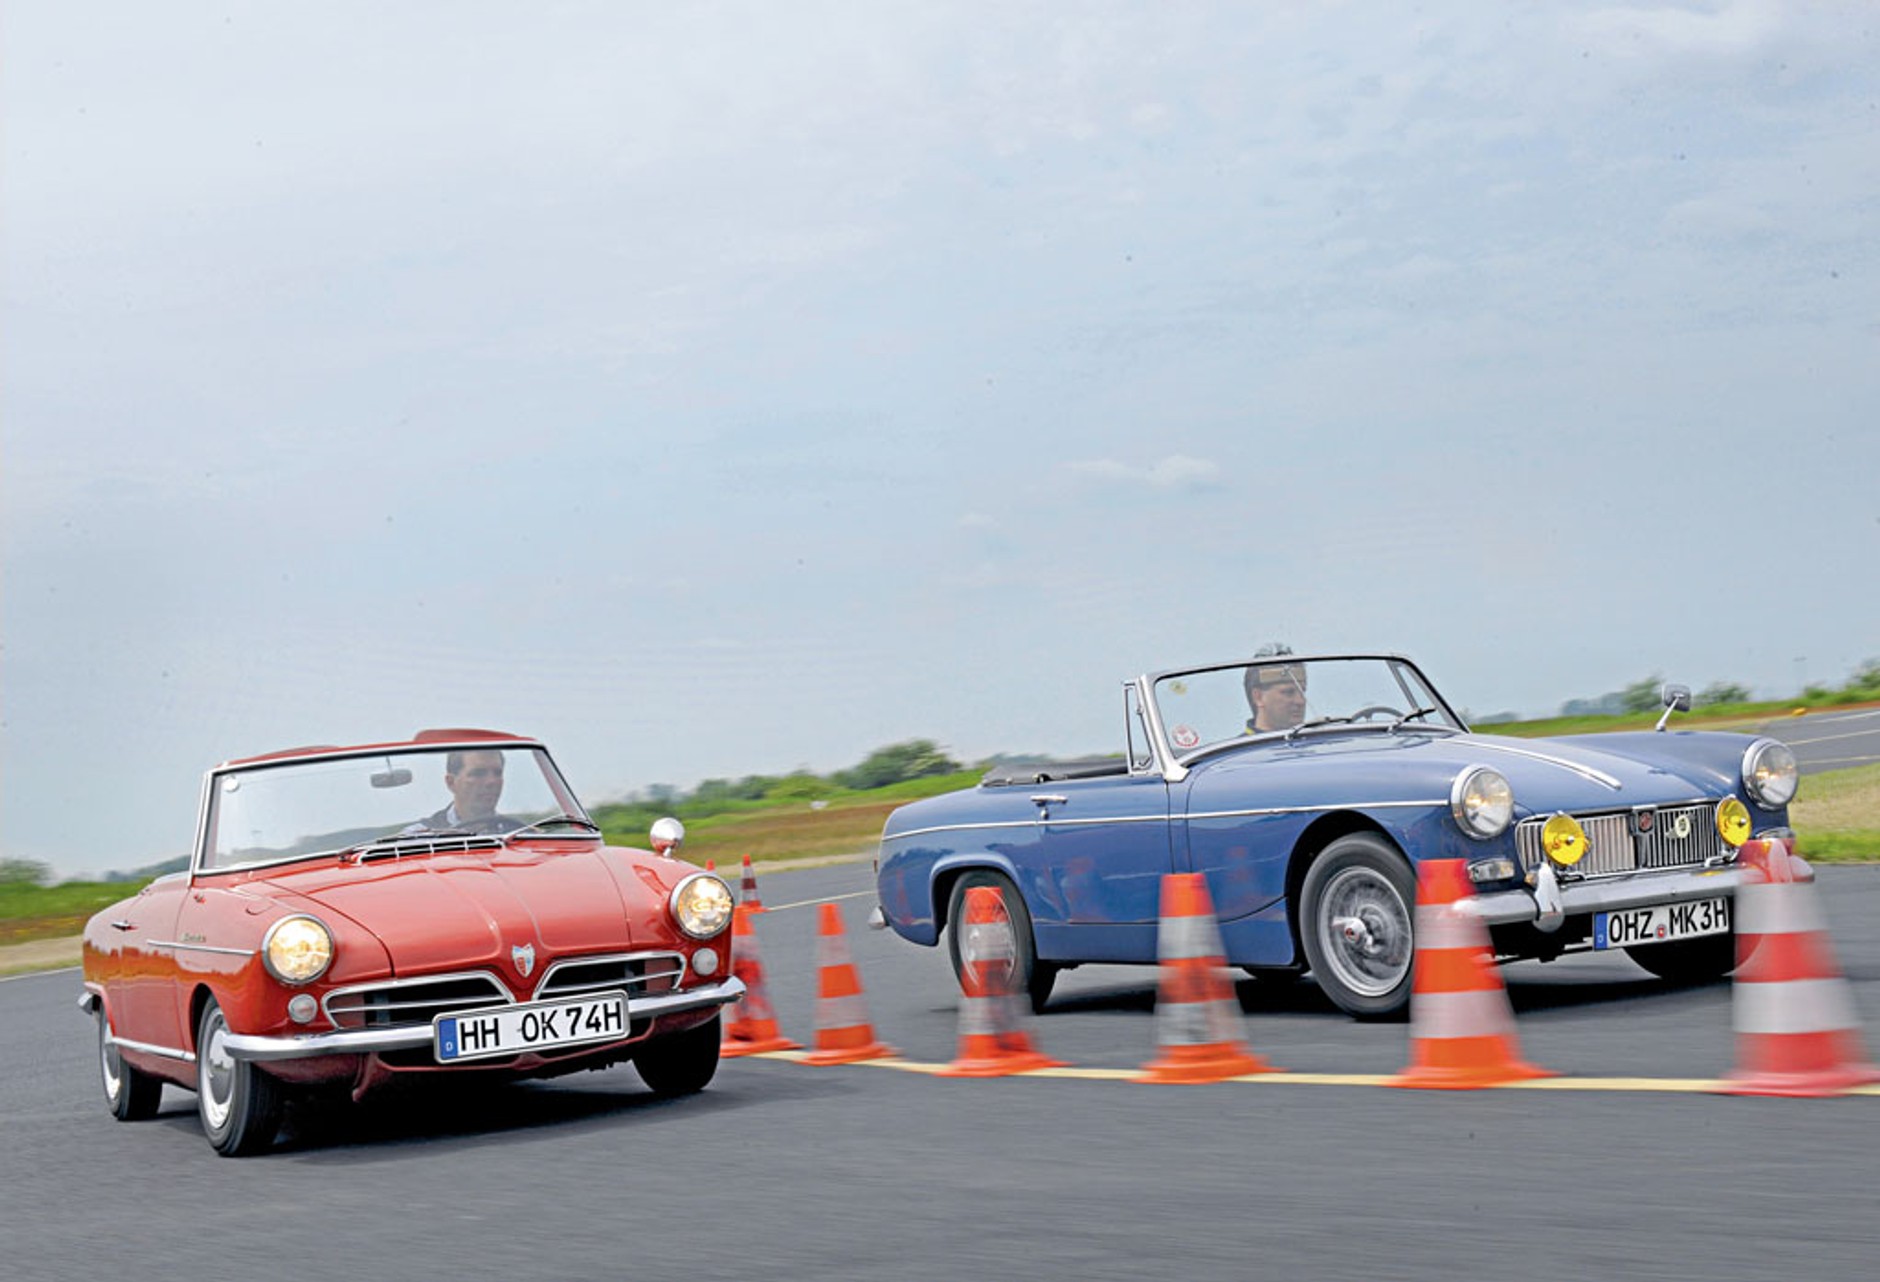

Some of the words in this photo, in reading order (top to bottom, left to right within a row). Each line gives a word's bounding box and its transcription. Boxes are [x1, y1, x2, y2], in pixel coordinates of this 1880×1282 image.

[1609, 910, 1654, 943] OHZ
[460, 1017, 500, 1051] HH
[521, 1009, 559, 1042] OK
[566, 1001, 622, 1036] 74H
